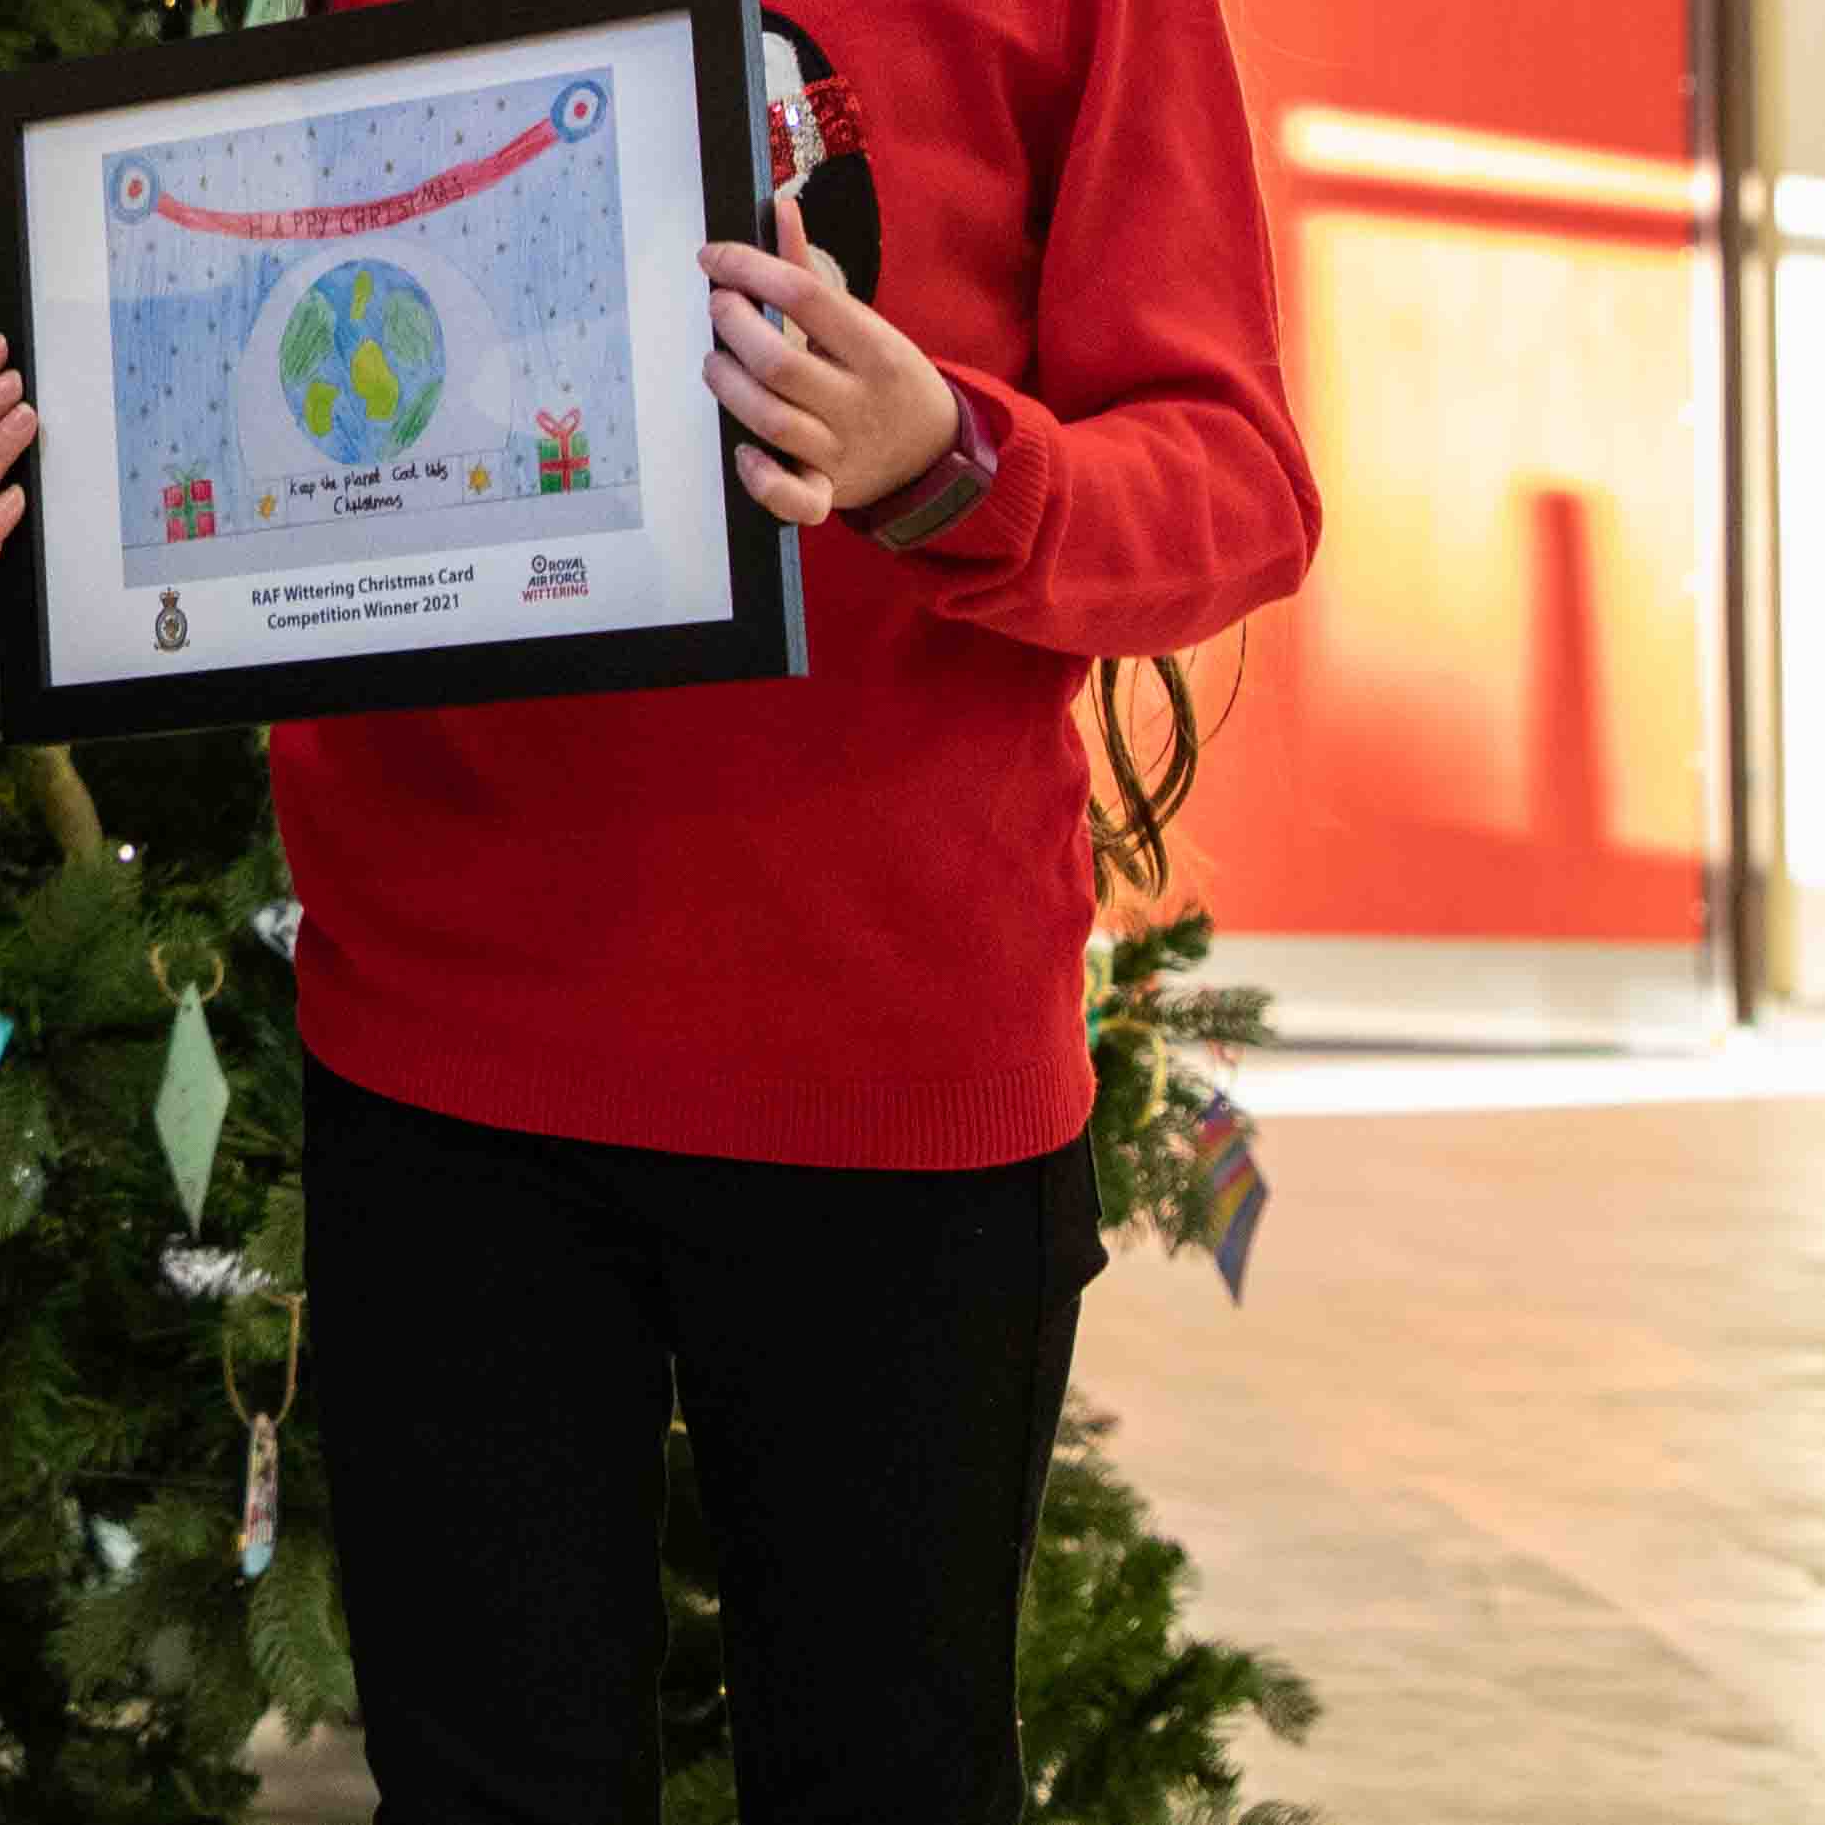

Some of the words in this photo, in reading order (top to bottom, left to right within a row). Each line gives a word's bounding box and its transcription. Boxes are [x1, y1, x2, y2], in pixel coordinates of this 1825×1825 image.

[249, 209, 329, 240] HAPPY
[340, 176, 463, 235] CHRISTMAS
[549, 558, 585, 571] ROYAL
[252, 586, 280, 605] RAF
[284, 581, 355, 602] Wittering
[358, 574, 435, 593] Christmas
[438, 564, 475, 584] Card
[522, 584, 589, 600] WITTERING
[528, 575, 547, 588] AIR
[549, 571, 586, 585] FORCE
[268, 606, 361, 630] Competition
[363, 599, 419, 619] Winner
[422, 593, 459, 612] 2021
